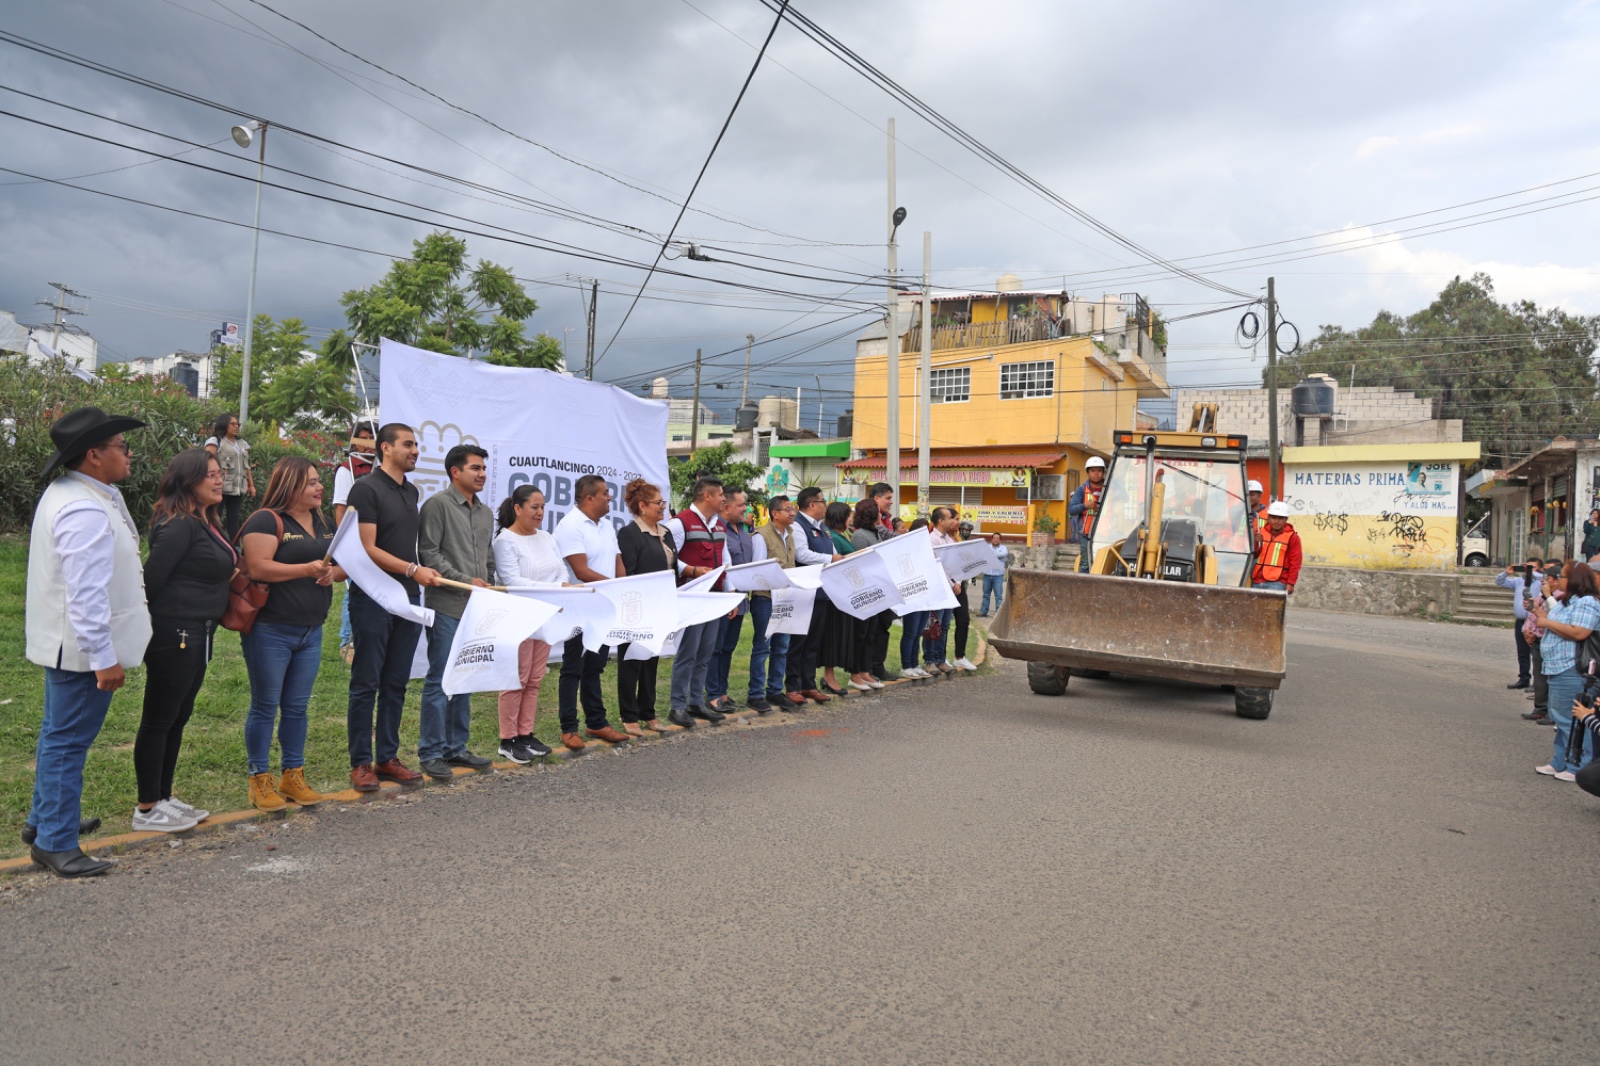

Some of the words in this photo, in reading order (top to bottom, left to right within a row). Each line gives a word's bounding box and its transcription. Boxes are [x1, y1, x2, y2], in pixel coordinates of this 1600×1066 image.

[509, 456, 595, 474] CUAUTLANCINGO
[596, 465, 617, 477] 2024
[969, 471, 992, 483] PEDRO
[1295, 472, 1361, 485] MATERIAS
[1368, 472, 1407, 486] PRIMA
[850, 588, 883, 606] GOBIERNO
[853, 593, 886, 611] MUNICIPAL
